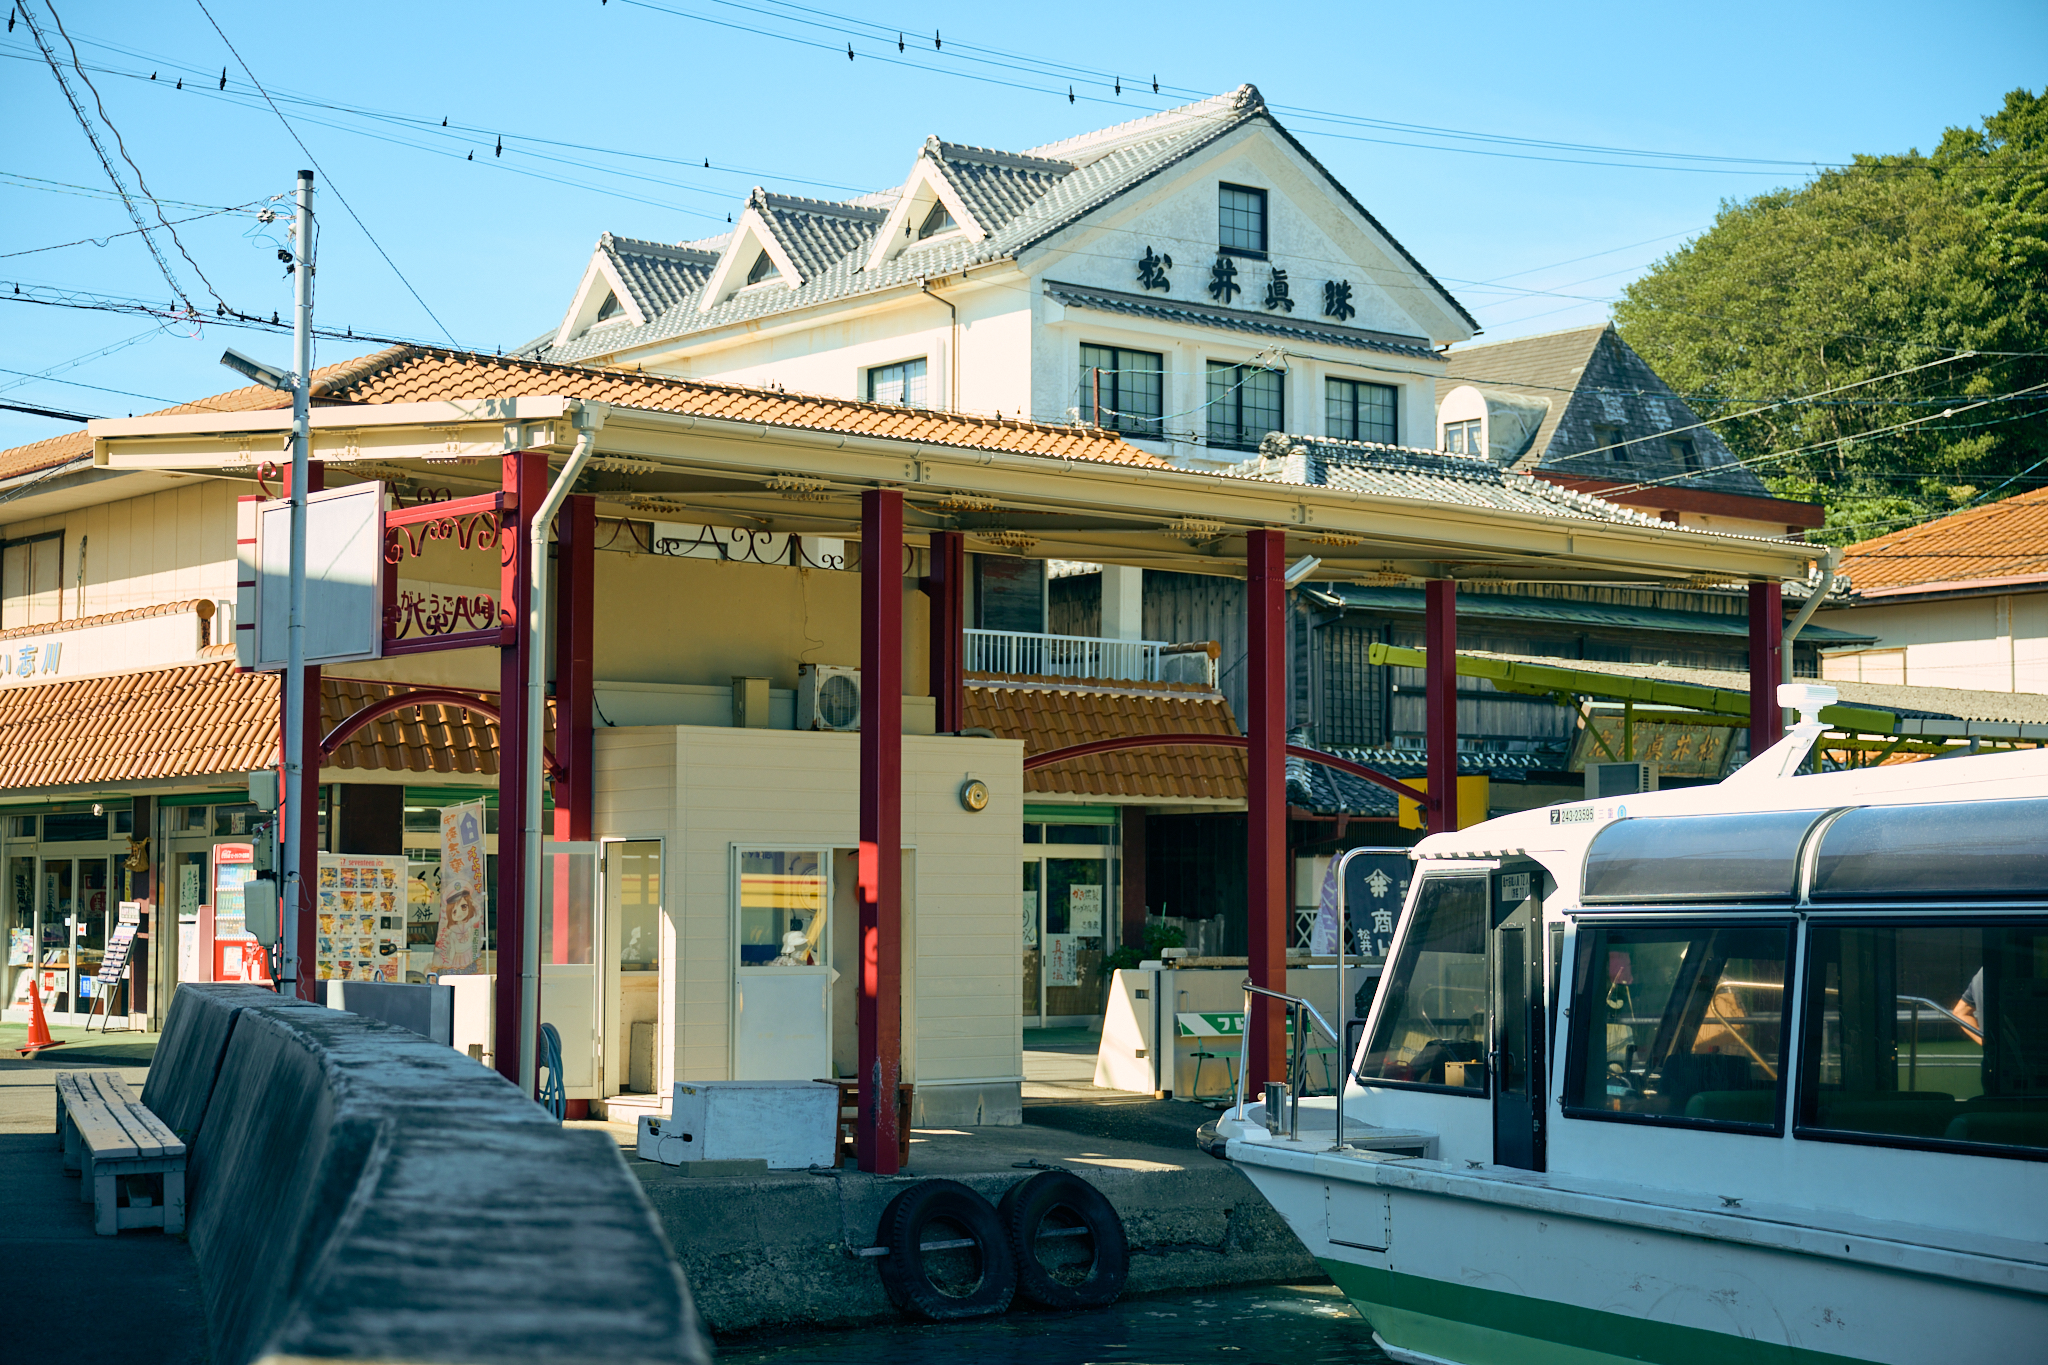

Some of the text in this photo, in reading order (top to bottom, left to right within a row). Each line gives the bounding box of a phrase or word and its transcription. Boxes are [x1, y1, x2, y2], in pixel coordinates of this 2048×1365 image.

[1561, 808, 1594, 823] 243-23595
[348, 859, 375, 867] seventeen
[376, 858, 384, 867] ice
